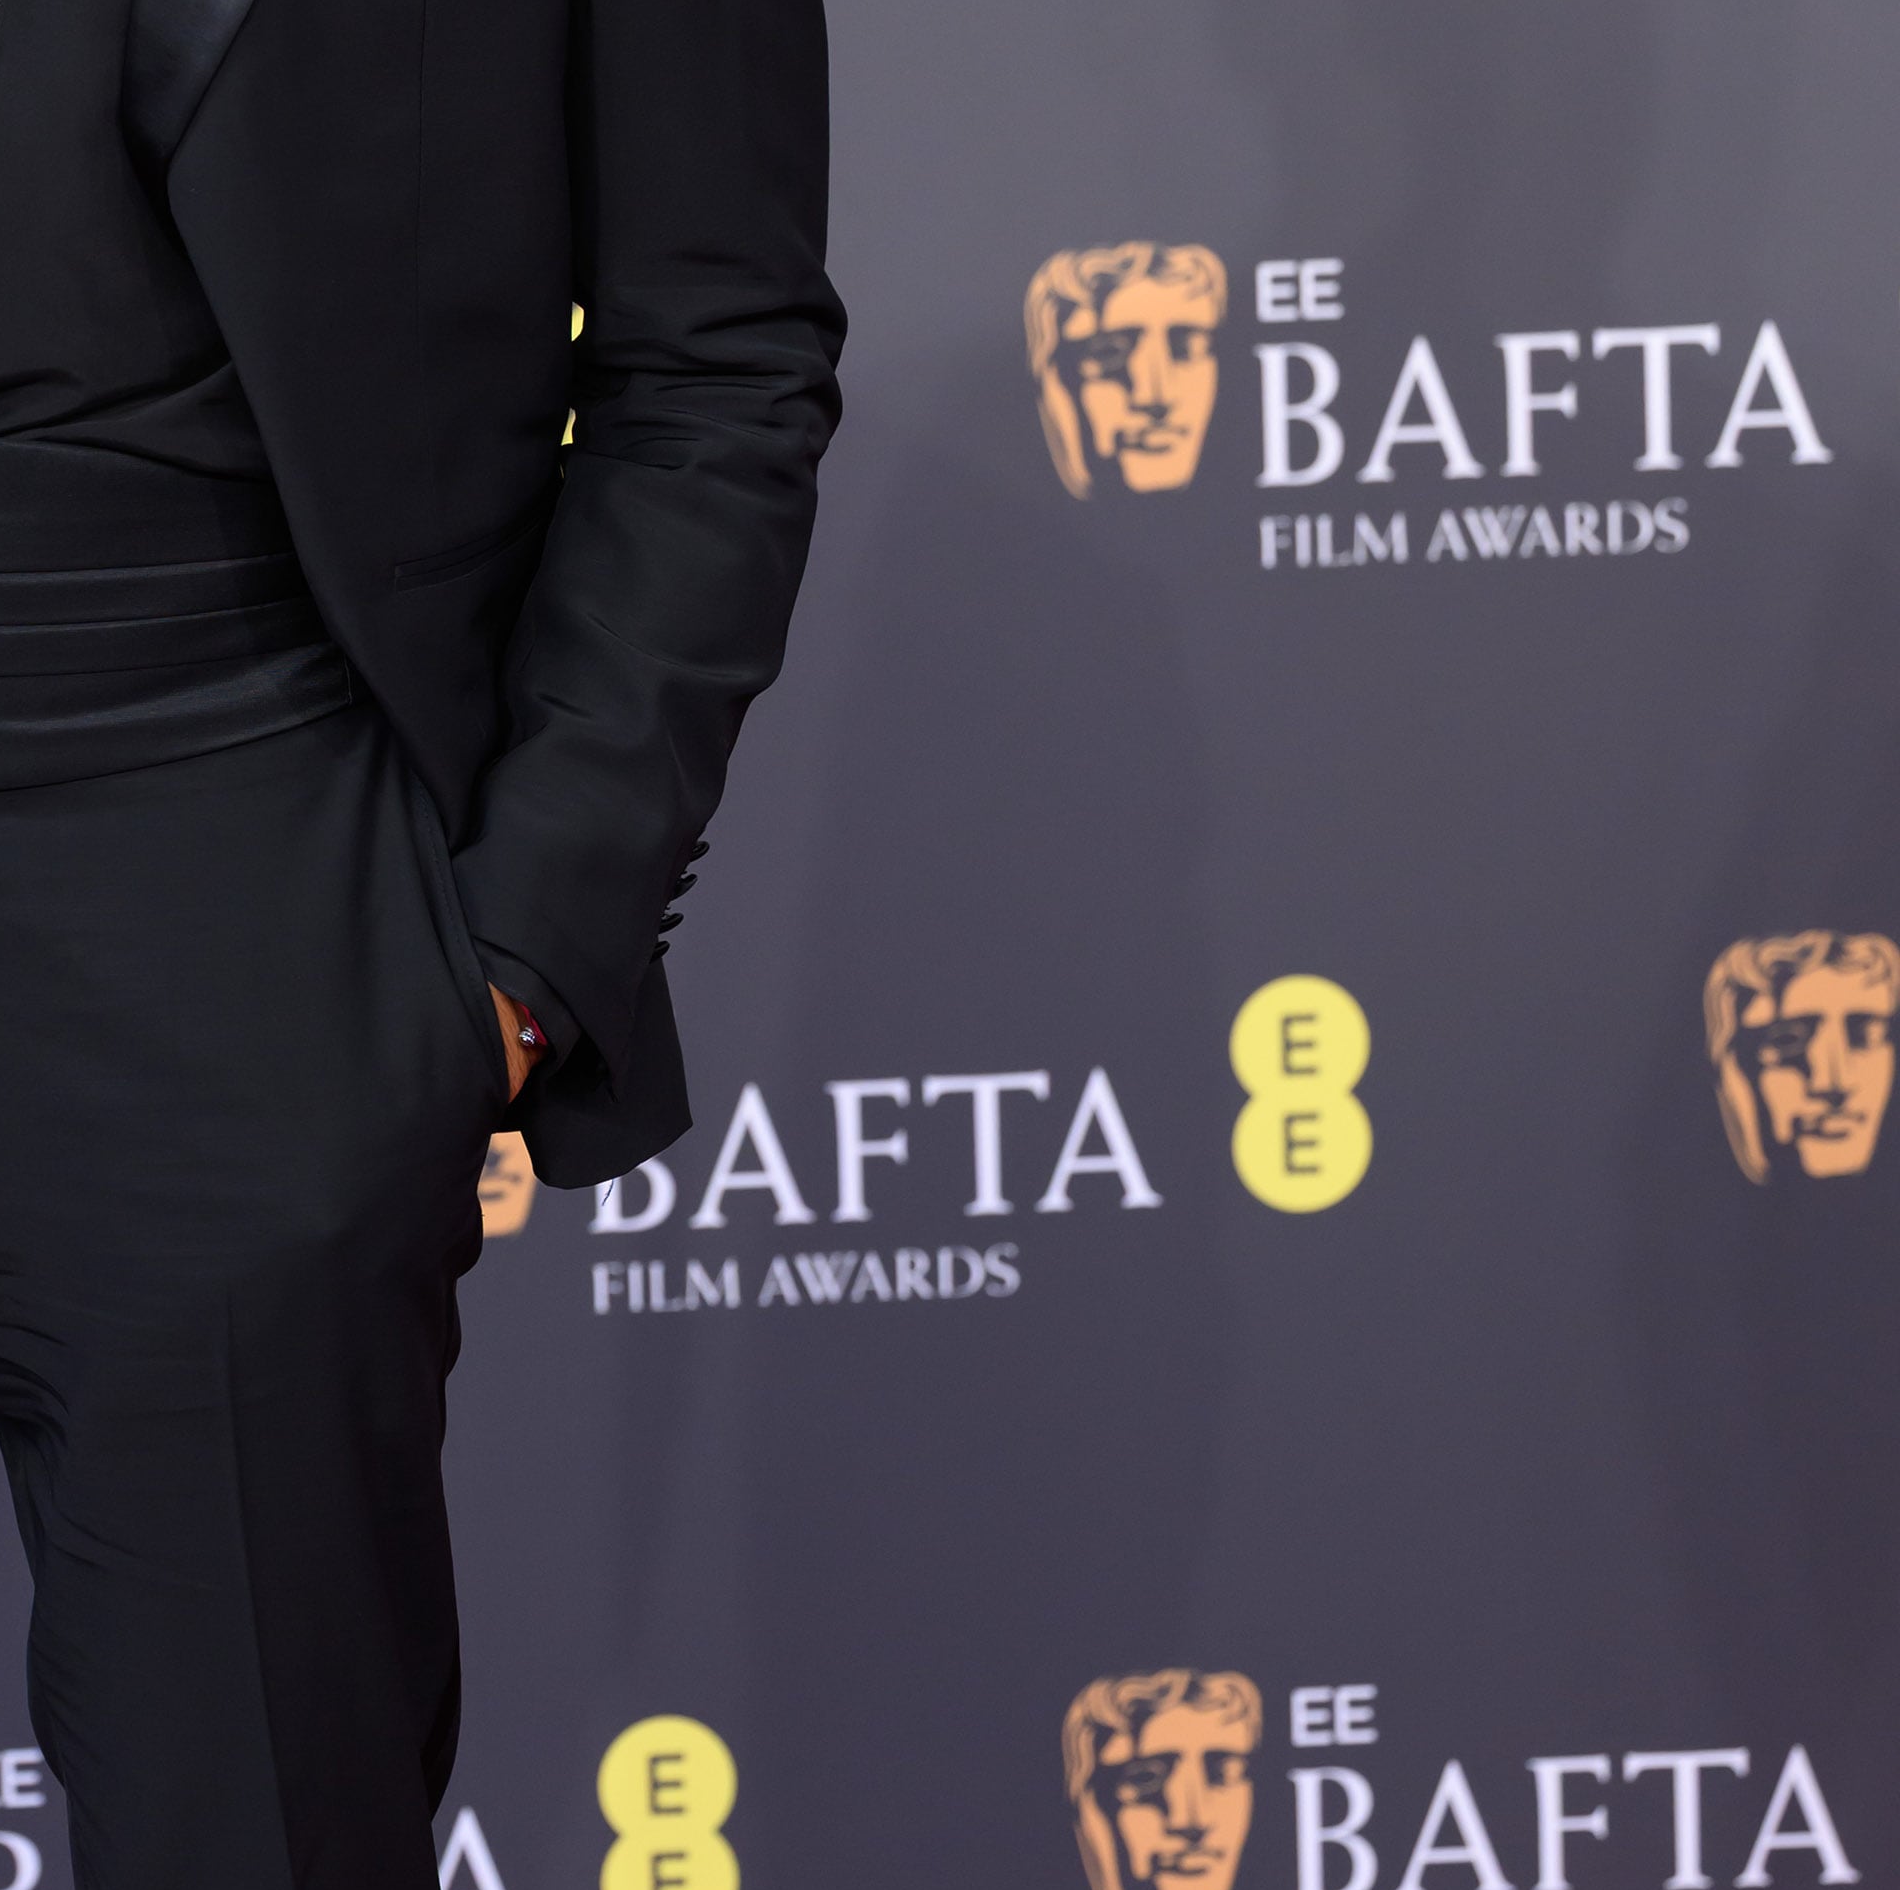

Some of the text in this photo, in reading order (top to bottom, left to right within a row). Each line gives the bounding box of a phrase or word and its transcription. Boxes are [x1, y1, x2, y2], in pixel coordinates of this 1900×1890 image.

[1255, 258, 1344, 323] EE
[1254, 320, 1833, 488] BAFTA
[1259, 498, 1690, 569] FILM AWARDS
[592, 1243, 1021, 1315] FILM AWARDS
[1290, 1684, 1378, 1748] EE
